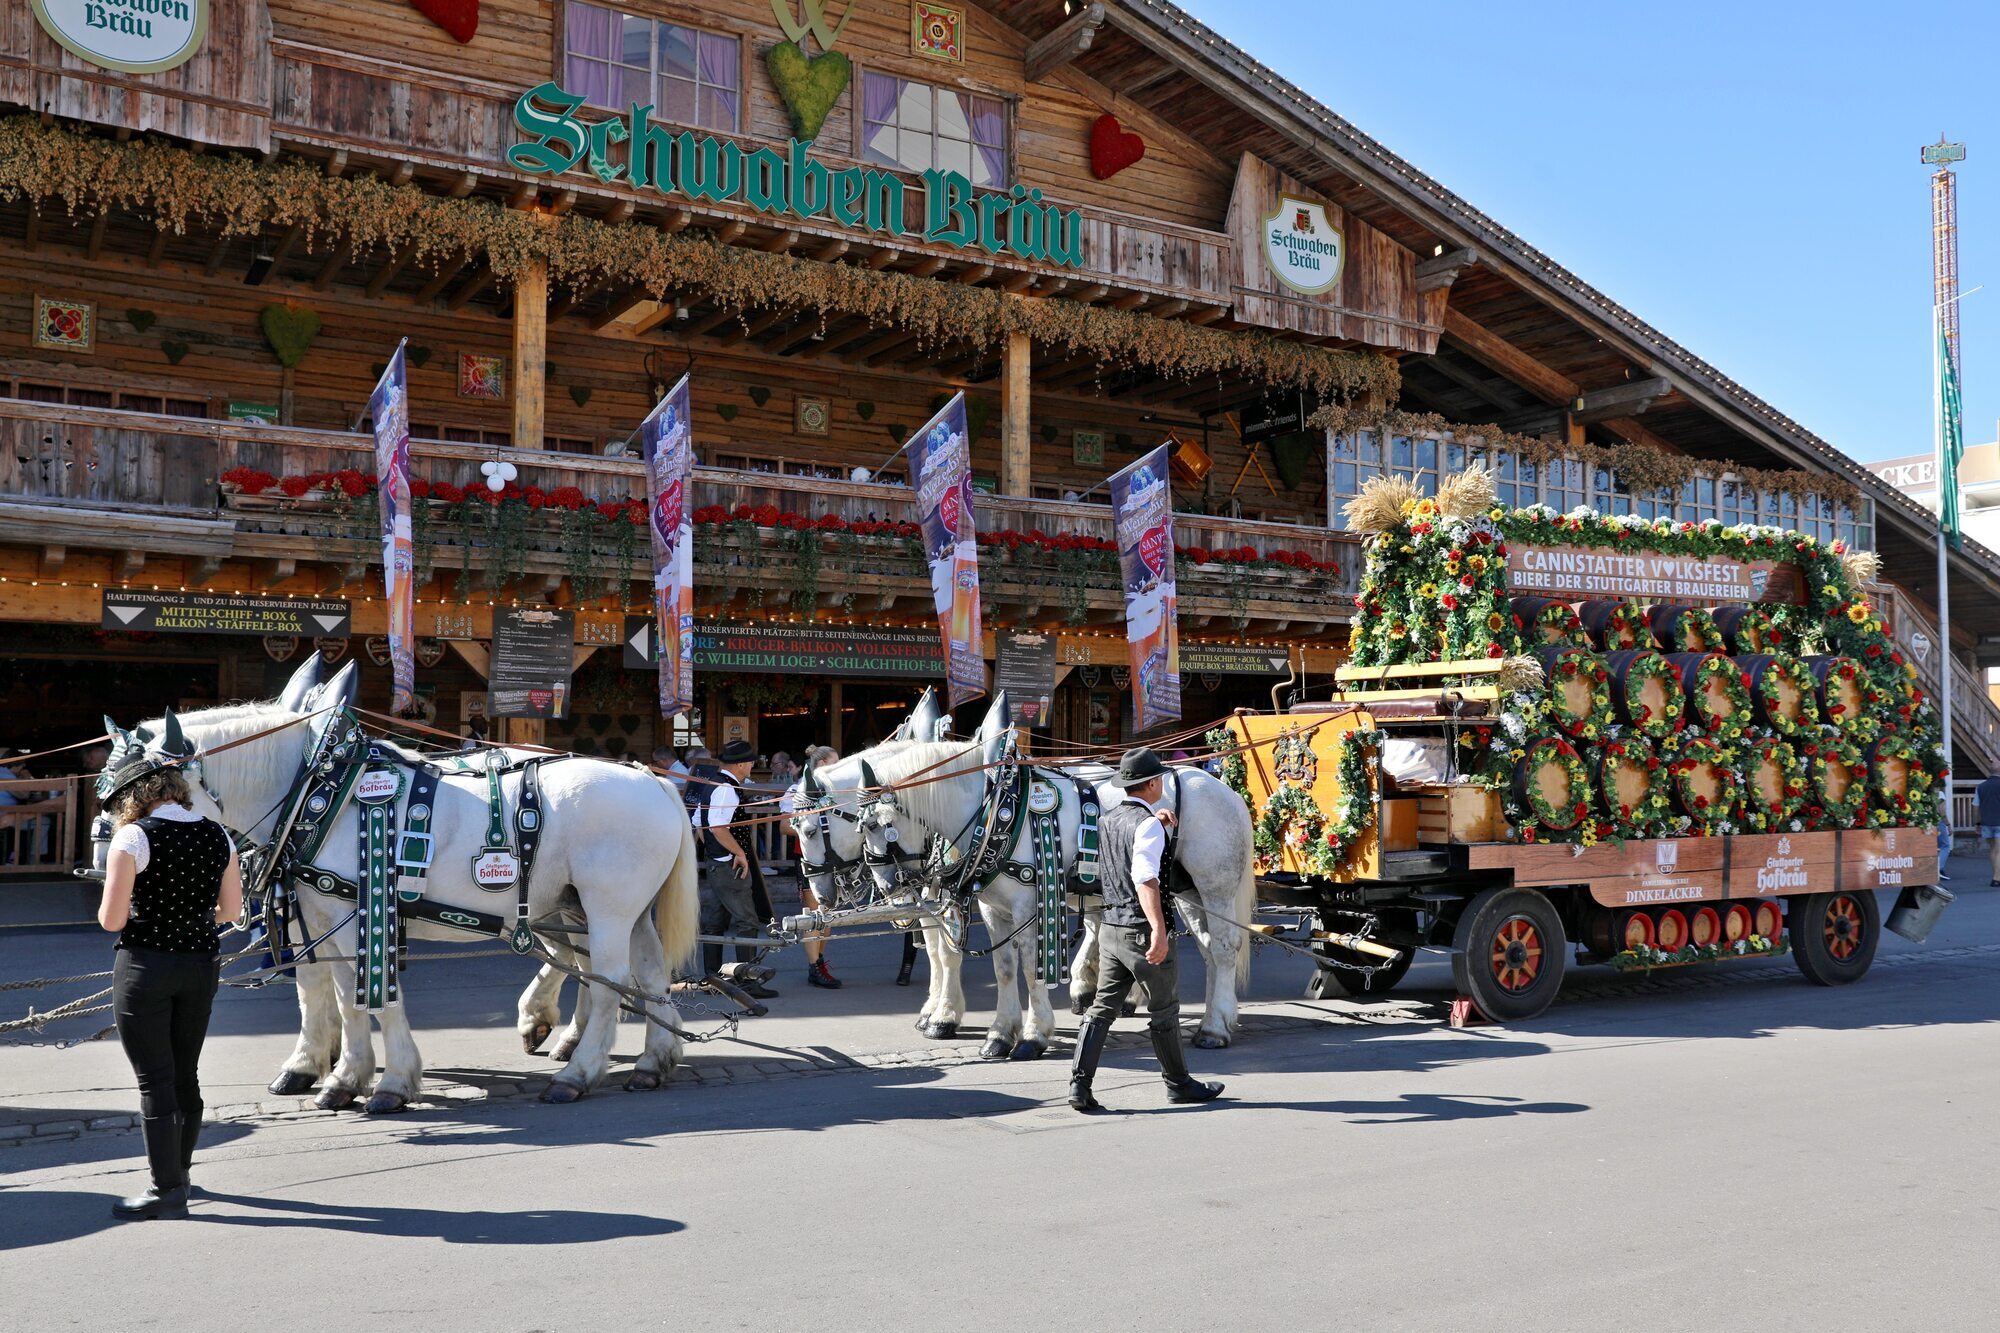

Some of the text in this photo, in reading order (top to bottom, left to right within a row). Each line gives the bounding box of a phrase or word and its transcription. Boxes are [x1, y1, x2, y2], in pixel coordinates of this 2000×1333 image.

[84, 2, 152, 38] Bräu
[506, 80, 1085, 268] Schwaben Bräu
[1271, 229, 1337, 257] Schwaben
[1288, 250, 1321, 271] Bräu
[1523, 550, 1644, 577] CANNSTATTER
[1513, 570, 1551, 588] BIERE
[1556, 572, 1581, 589] DER
[1586, 574, 1672, 595] STUTTGARTER
[1676, 581, 1750, 599] BRAUEREIEN
[106, 593, 178, 604] HAUPTEINGANG
[193, 597, 214, 605] UND
[229, 599, 248, 607] DEN
[249, 600, 309, 609] RESERVIERTEN
[311, 602, 347, 611] PLÄTZEN
[161, 606, 297, 621] MITTELSCHIFF BOX 6
[155, 617, 303, 632] BALKON STÄFFELE-BOX
[701, 626, 761, 636] RESERVIERTEN
[763, 627, 799, 637] PLÄTZEN
[800, 629, 824, 638] BITTE
[825, 630, 892, 641] SEITENEINGÄNGE
[893, 634, 916, 642] LINKS
[916, 634, 942, 643] BENUT
[727, 636, 845, 654] KRÜGER-BALKON
[854, 643, 944, 657] VOLKSFEST-BO
[706, 652, 776, 667] WILHELM
[780, 655, 817, 668] LOGE
[826, 656, 946, 672] SCHLACHTHOF-BO
[1179, 661, 1221, 671] EQUIPE-BOX
[1188, 654, 1238, 662] MITTELSCHIFF
[359, 784, 393, 794] Hofbräu
[1660, 865, 1673, 873] CD
[1766, 856, 1804, 869] Stuttgarter
[1866, 854, 1913, 871] Schwaben
[480, 868, 513, 880] Hofbräu
[1757, 867, 1808, 893] Hofbräu
[1879, 870, 1902, 885] Bräu
[1626, 886, 1704, 903] DINKELACKER
